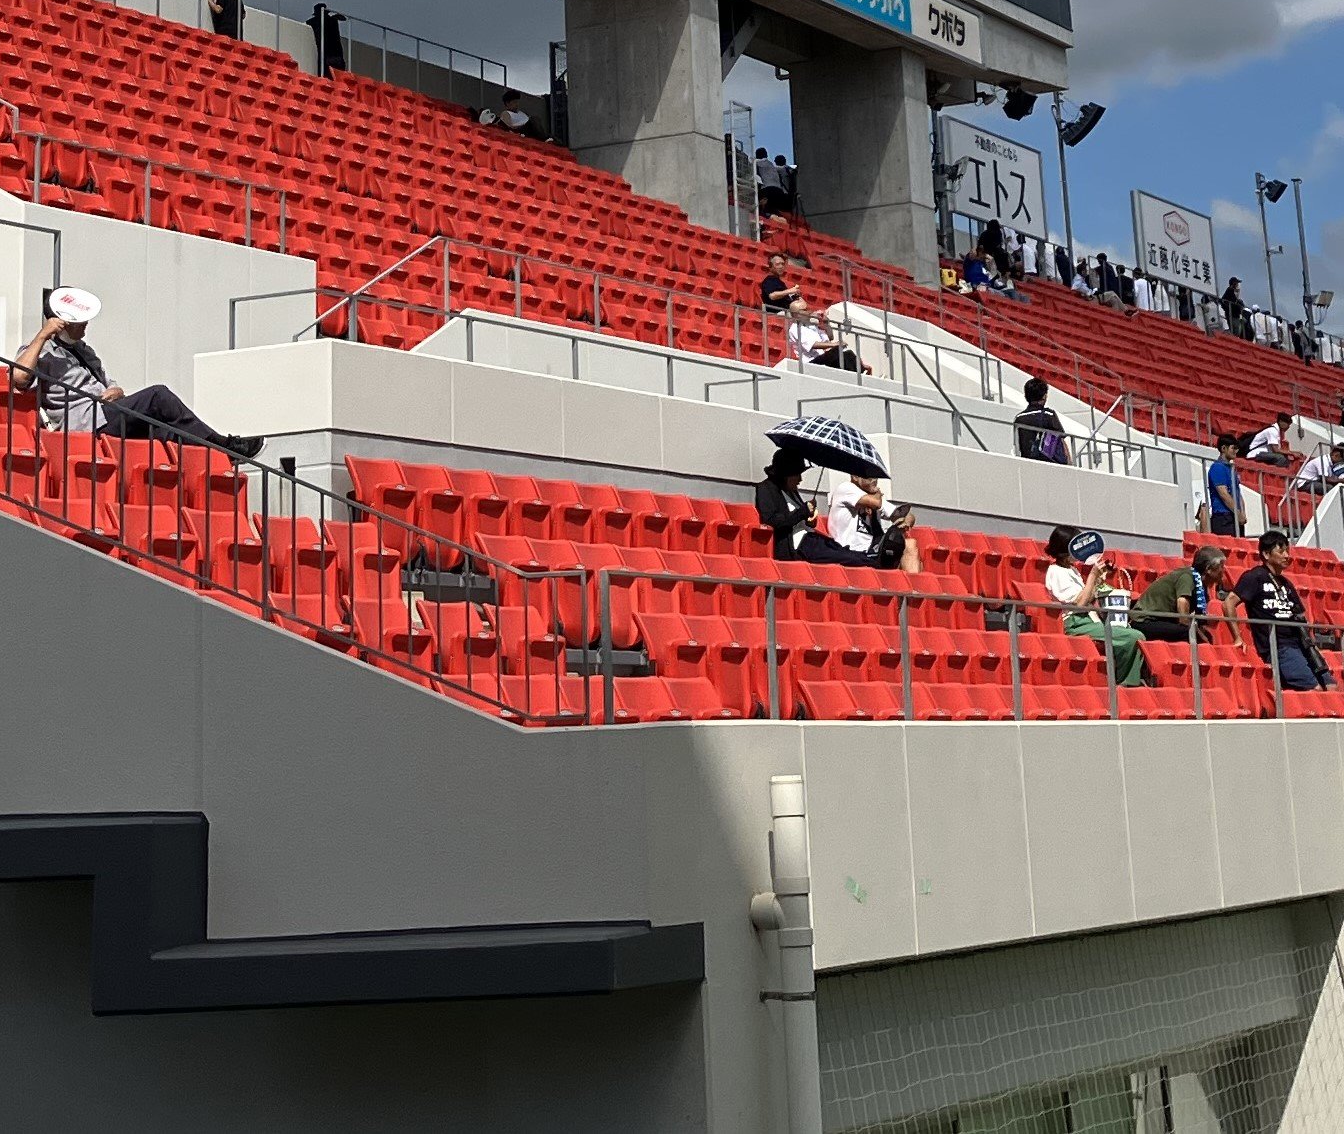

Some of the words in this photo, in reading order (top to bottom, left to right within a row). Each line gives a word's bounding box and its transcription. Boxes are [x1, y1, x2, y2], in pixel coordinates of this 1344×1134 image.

[928, 2, 966, 47] クボタ
[968, 156, 1032, 224] エトス
[1147, 241, 1212, 286] 近藤化学工業
